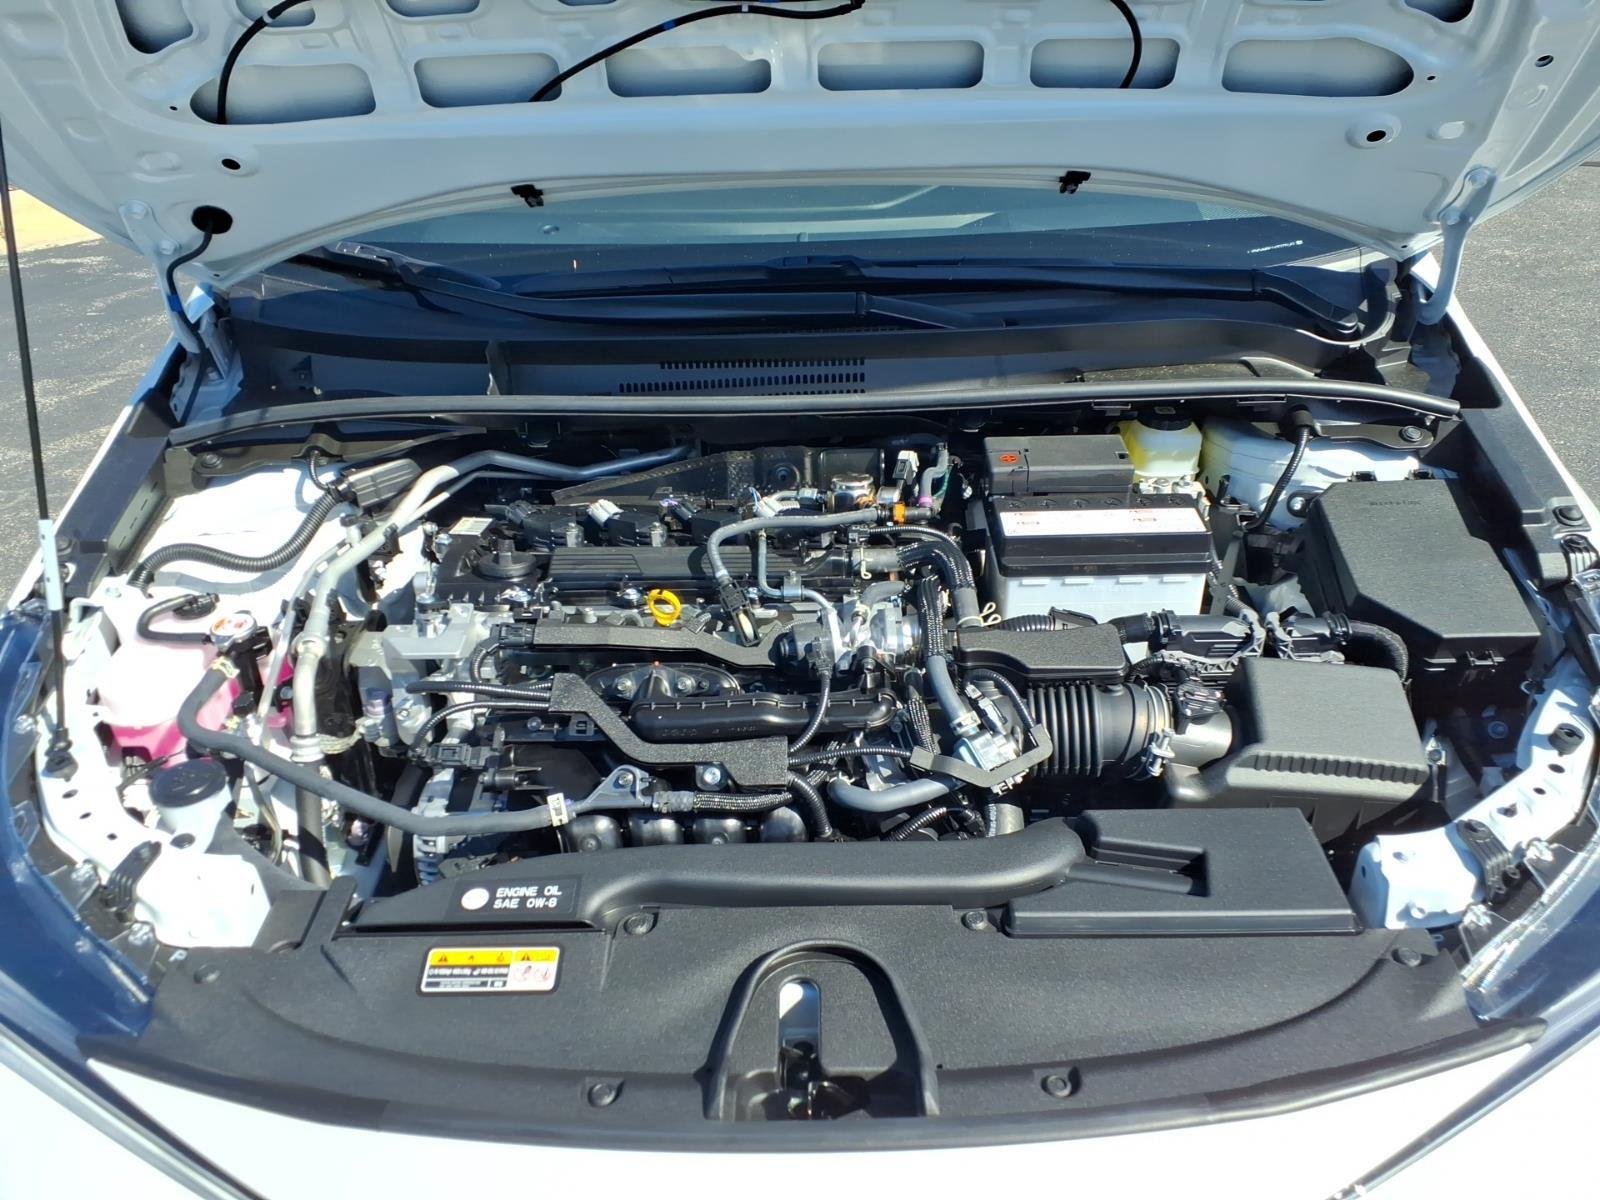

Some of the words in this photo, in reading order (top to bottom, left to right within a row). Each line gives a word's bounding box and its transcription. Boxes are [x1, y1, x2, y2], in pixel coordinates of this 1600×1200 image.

[496, 886, 539, 898] ENGINE
[543, 885, 563, 896] OIL
[493, 898, 520, 909] SAE
